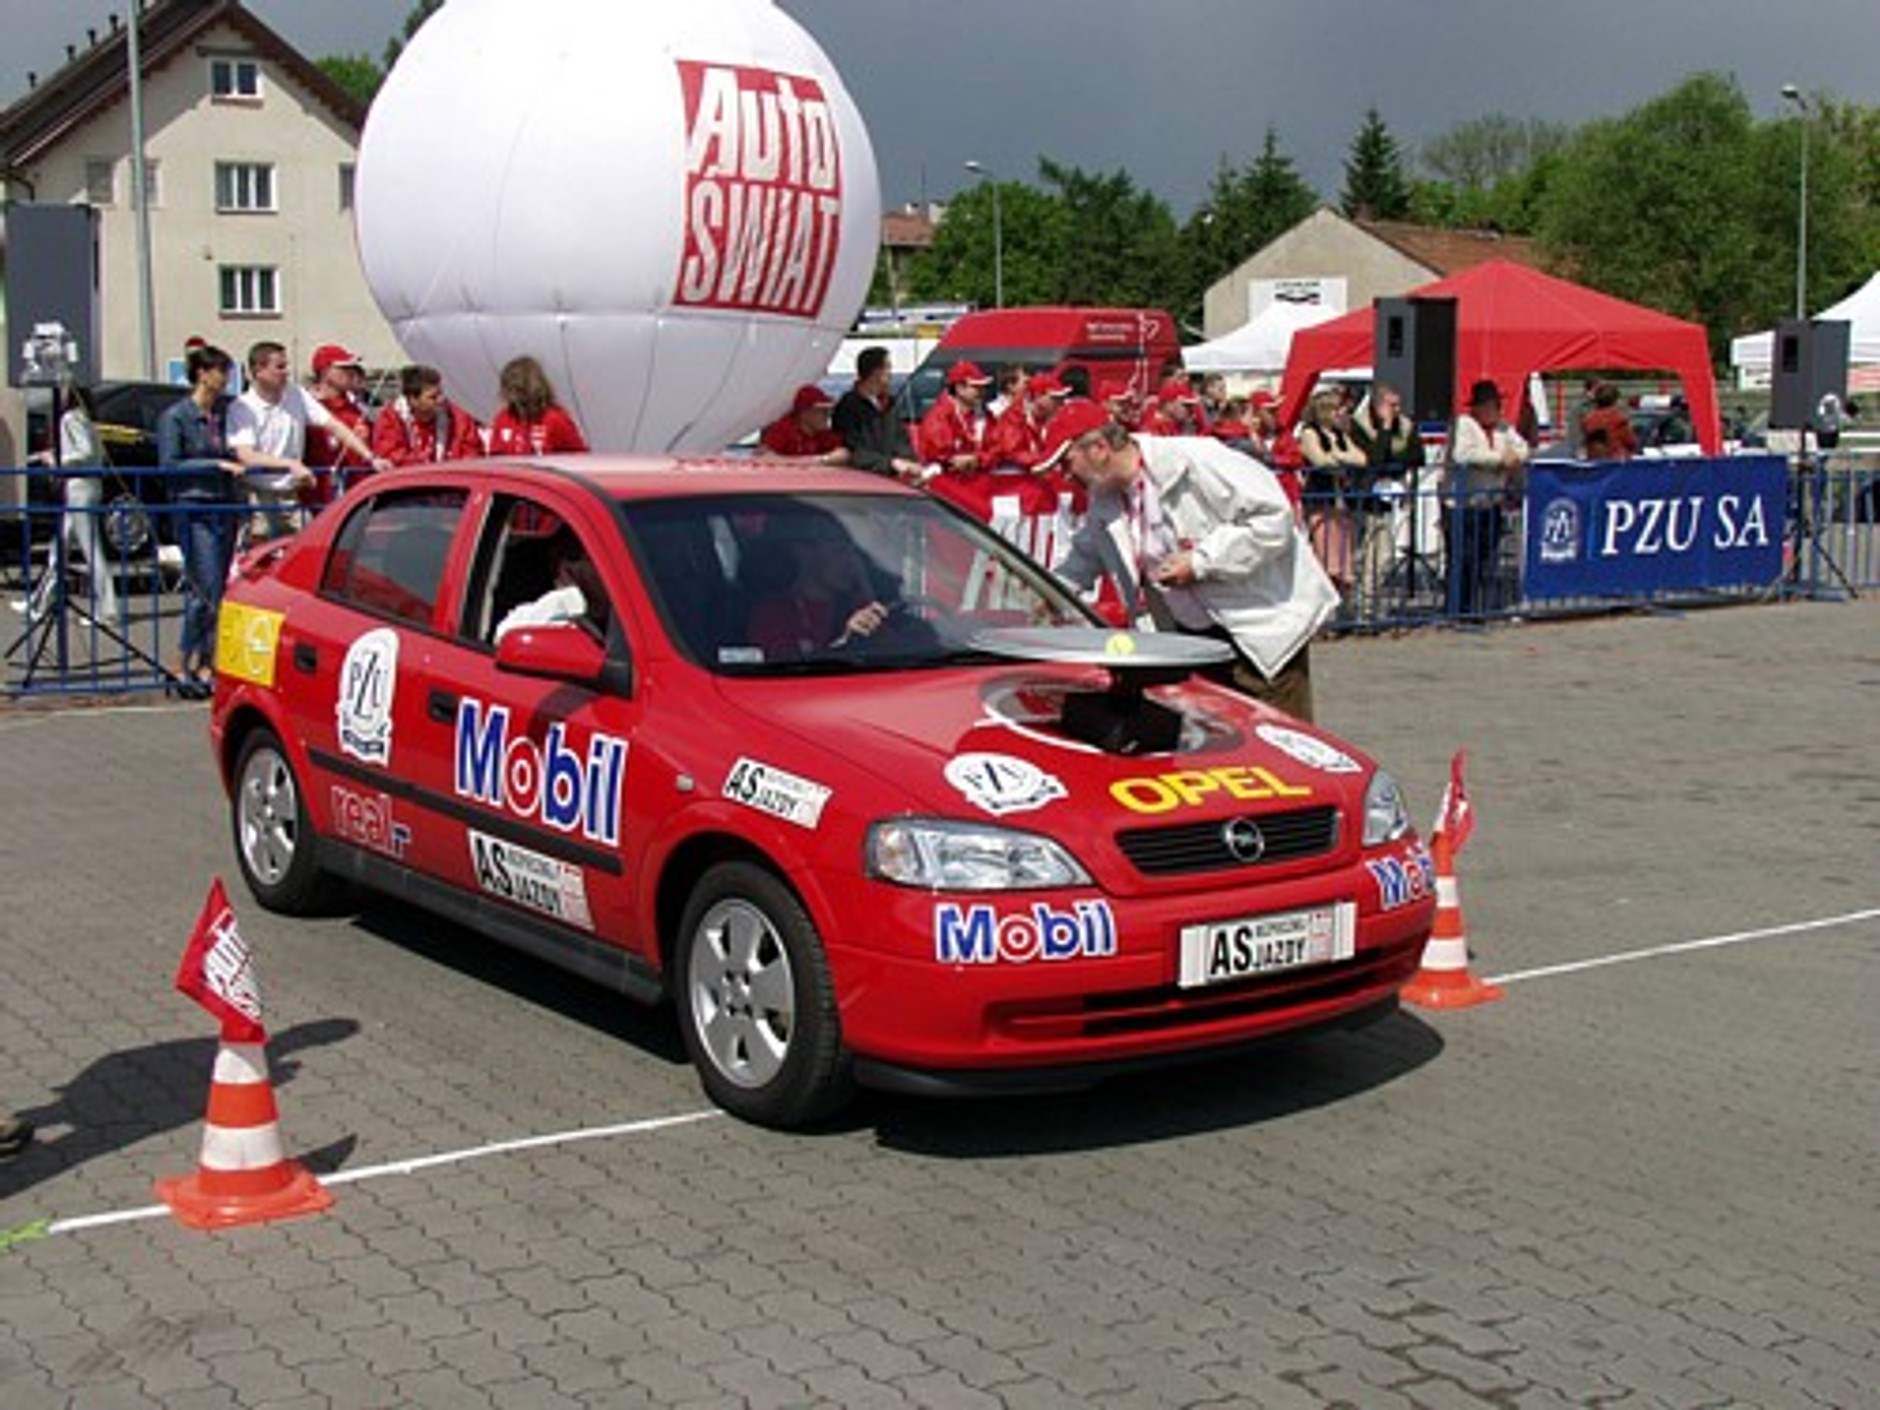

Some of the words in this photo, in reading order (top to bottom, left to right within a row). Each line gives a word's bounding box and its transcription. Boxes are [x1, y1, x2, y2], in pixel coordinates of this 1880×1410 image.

[1602, 498, 1703, 556] PZU
[1714, 495, 1769, 548] SA
[457, 697, 627, 845] Mobil
[725, 764, 765, 800] AS
[1109, 766, 1312, 814] OPEL
[476, 838, 513, 896] AS
[935, 901, 1115, 964] Mobil
[1210, 925, 1252, 976] AS
